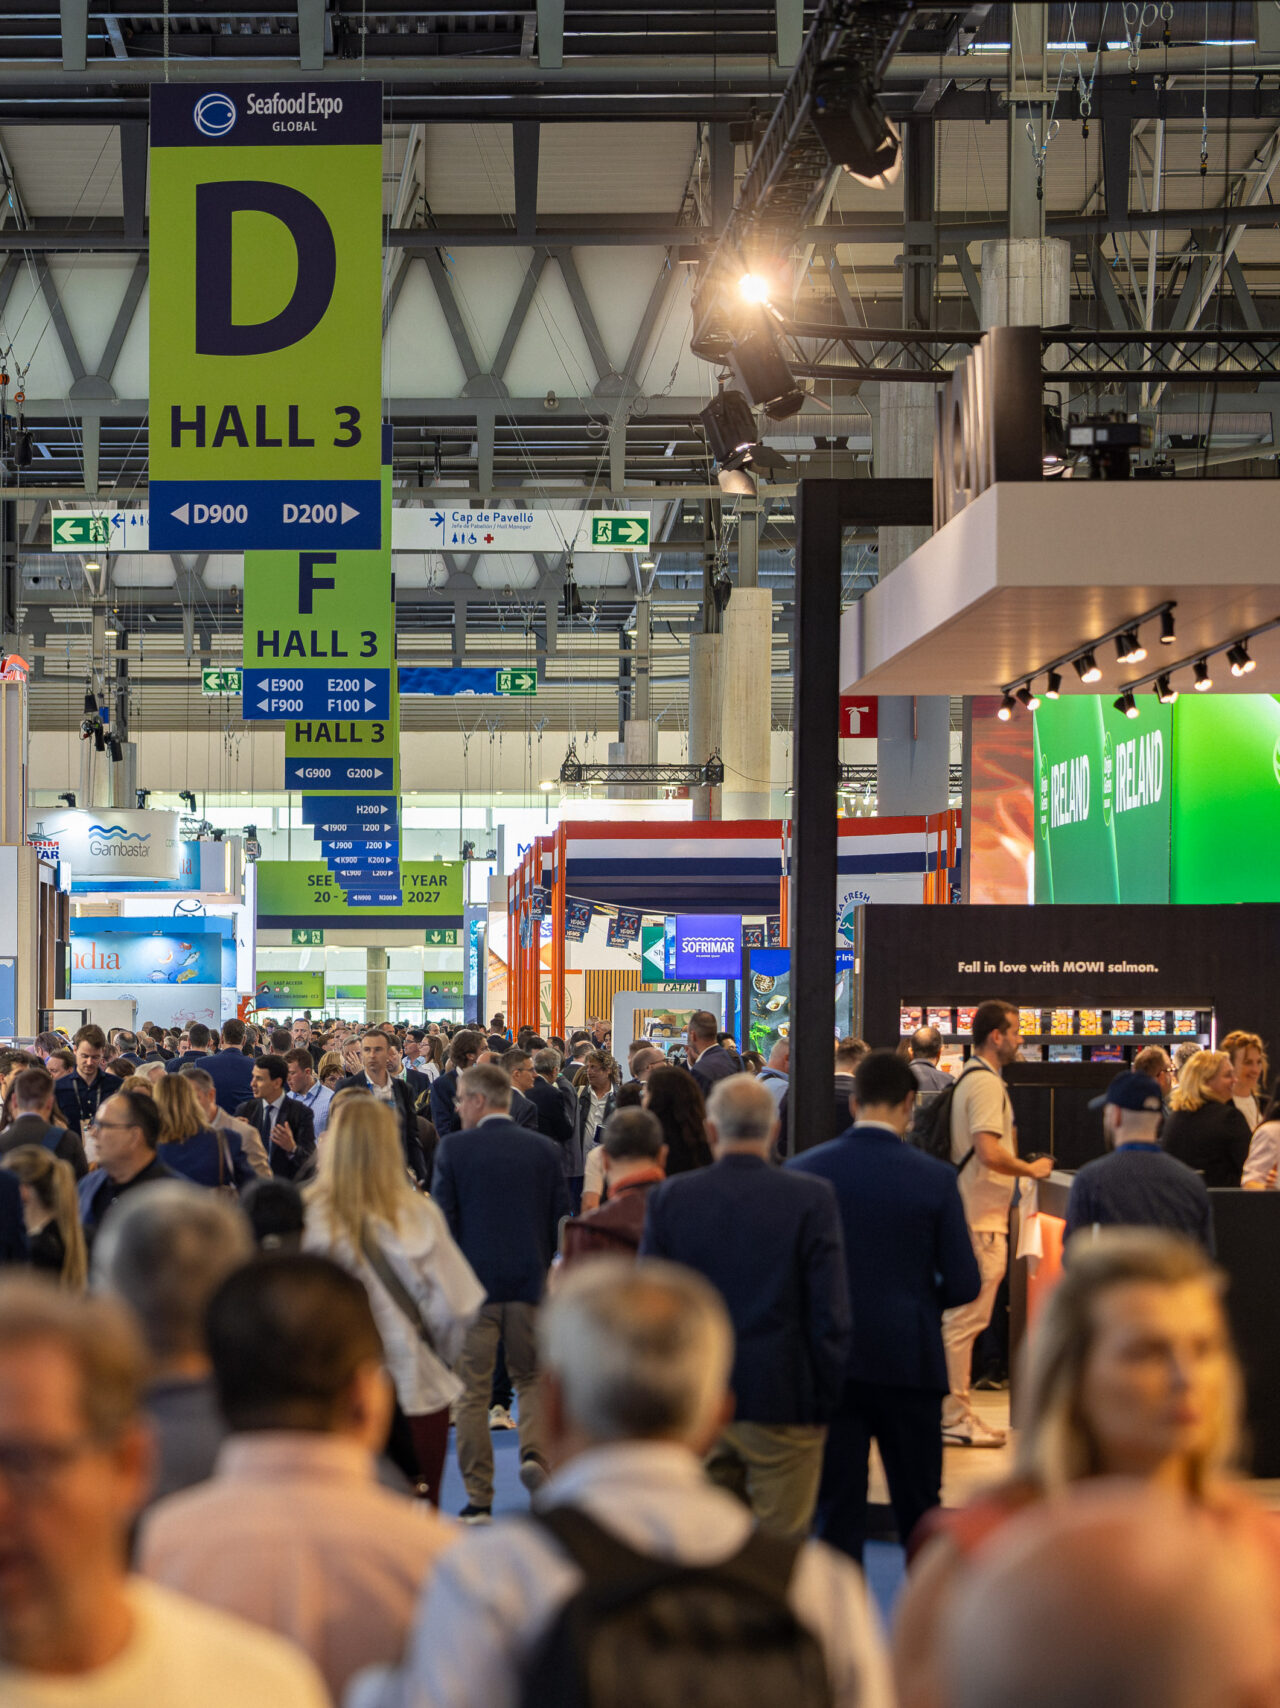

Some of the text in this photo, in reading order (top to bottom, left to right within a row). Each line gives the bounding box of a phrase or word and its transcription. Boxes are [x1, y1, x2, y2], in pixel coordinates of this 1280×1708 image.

[246, 92, 343, 119] Seafood Expo
[272, 121, 318, 132] GLOBAL
[195, 180, 337, 356] D
[170, 404, 362, 448] HALL 3
[193, 502, 337, 524] D900 D200
[451, 511, 534, 524] Cap de Pavelló
[299, 552, 337, 614] F
[256, 630, 378, 658] HALL 3
[271, 678, 360, 692] E900 E200
[271, 699, 360, 712] F900 F100
[295, 722, 385, 743] HALL 3
[305, 768, 373, 778] G900 G200
[1115, 729, 1163, 813] IRELAND
[1051, 754, 1090, 829] IRELAND
[356, 805, 379, 815] H200
[335, 841, 383, 850] J900 J200
[37, 850, 59, 859] TAR
[307, 875, 332, 887] SEE
[411, 875, 448, 886] YEAR
[314, 891, 331, 903] 20
[408, 891, 441, 903] 2027
[843, 890, 871, 903] FRESH
[681, 941, 735, 953] SOFRIMAR
[72, 942, 122, 970] ndia
[958, 961, 1159, 973] Fall in love with MOWI salmon.
